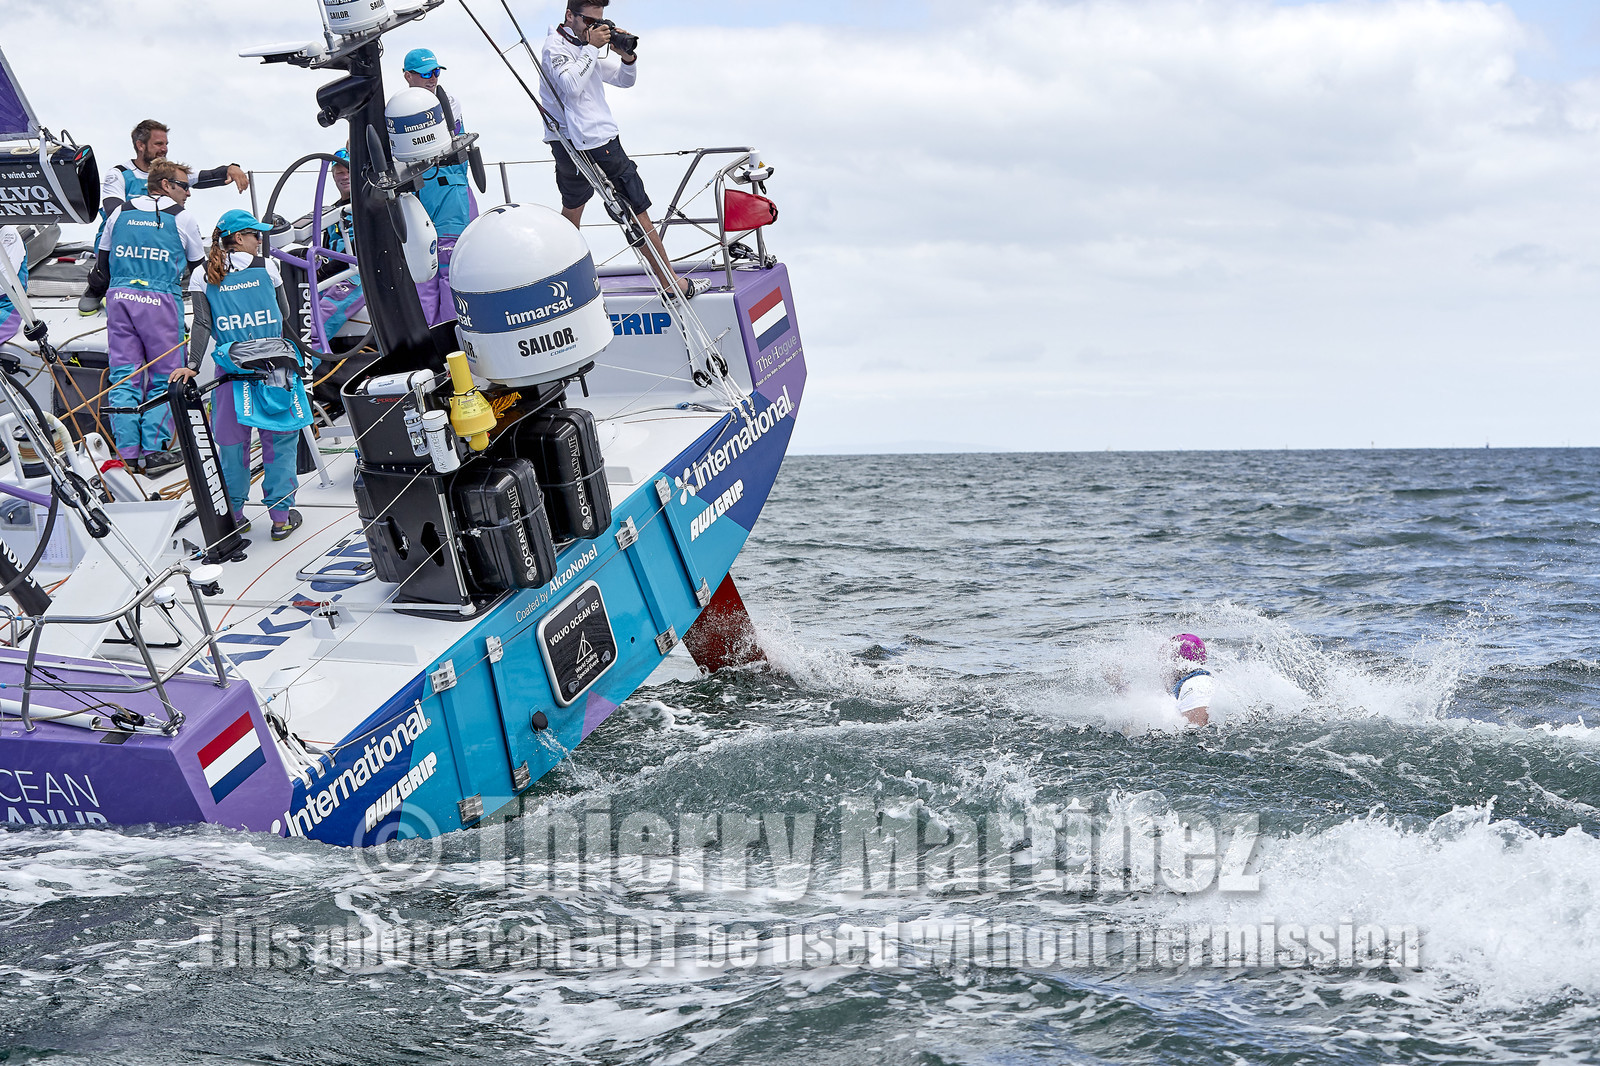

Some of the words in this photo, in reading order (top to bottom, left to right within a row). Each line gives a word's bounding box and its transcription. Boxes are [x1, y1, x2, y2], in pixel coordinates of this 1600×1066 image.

[404, 118, 437, 132] inmarsat
[412, 133, 436, 145] SAILOR
[7, 171, 26, 179] wind
[115, 245, 170, 262] SALTER
[113, 292, 161, 306] AkzoNobel
[219, 279, 260, 293] AkzoNobel
[216, 309, 277, 331] GRAEL
[505, 295, 574, 326] inmarsat
[518, 327, 575, 357] SAILOR
[756, 354, 773, 373] The
[771, 335, 798, 362] Hague
[692, 385, 792, 492] International
[187, 409, 229, 516] AWLGRIP
[691, 479, 745, 542] AWLGRIP
[517, 528, 533, 567] OCEAN
[516, 595, 540, 622] Coated
[539, 591, 548, 602] by
[549, 544, 598, 595] AkzoNobel
[549, 625, 570, 646] VOLVO
[570, 606, 591, 629] OCEAN
[591, 600, 600, 612] 65
[575, 660, 586, 674] World
[585, 652, 598, 666] Sailing
[576, 667, 589, 680] Special
[588, 658, 600, 672] Event
[284, 699, 428, 837] International
[365, 751, 437, 833] AWLGRIP
